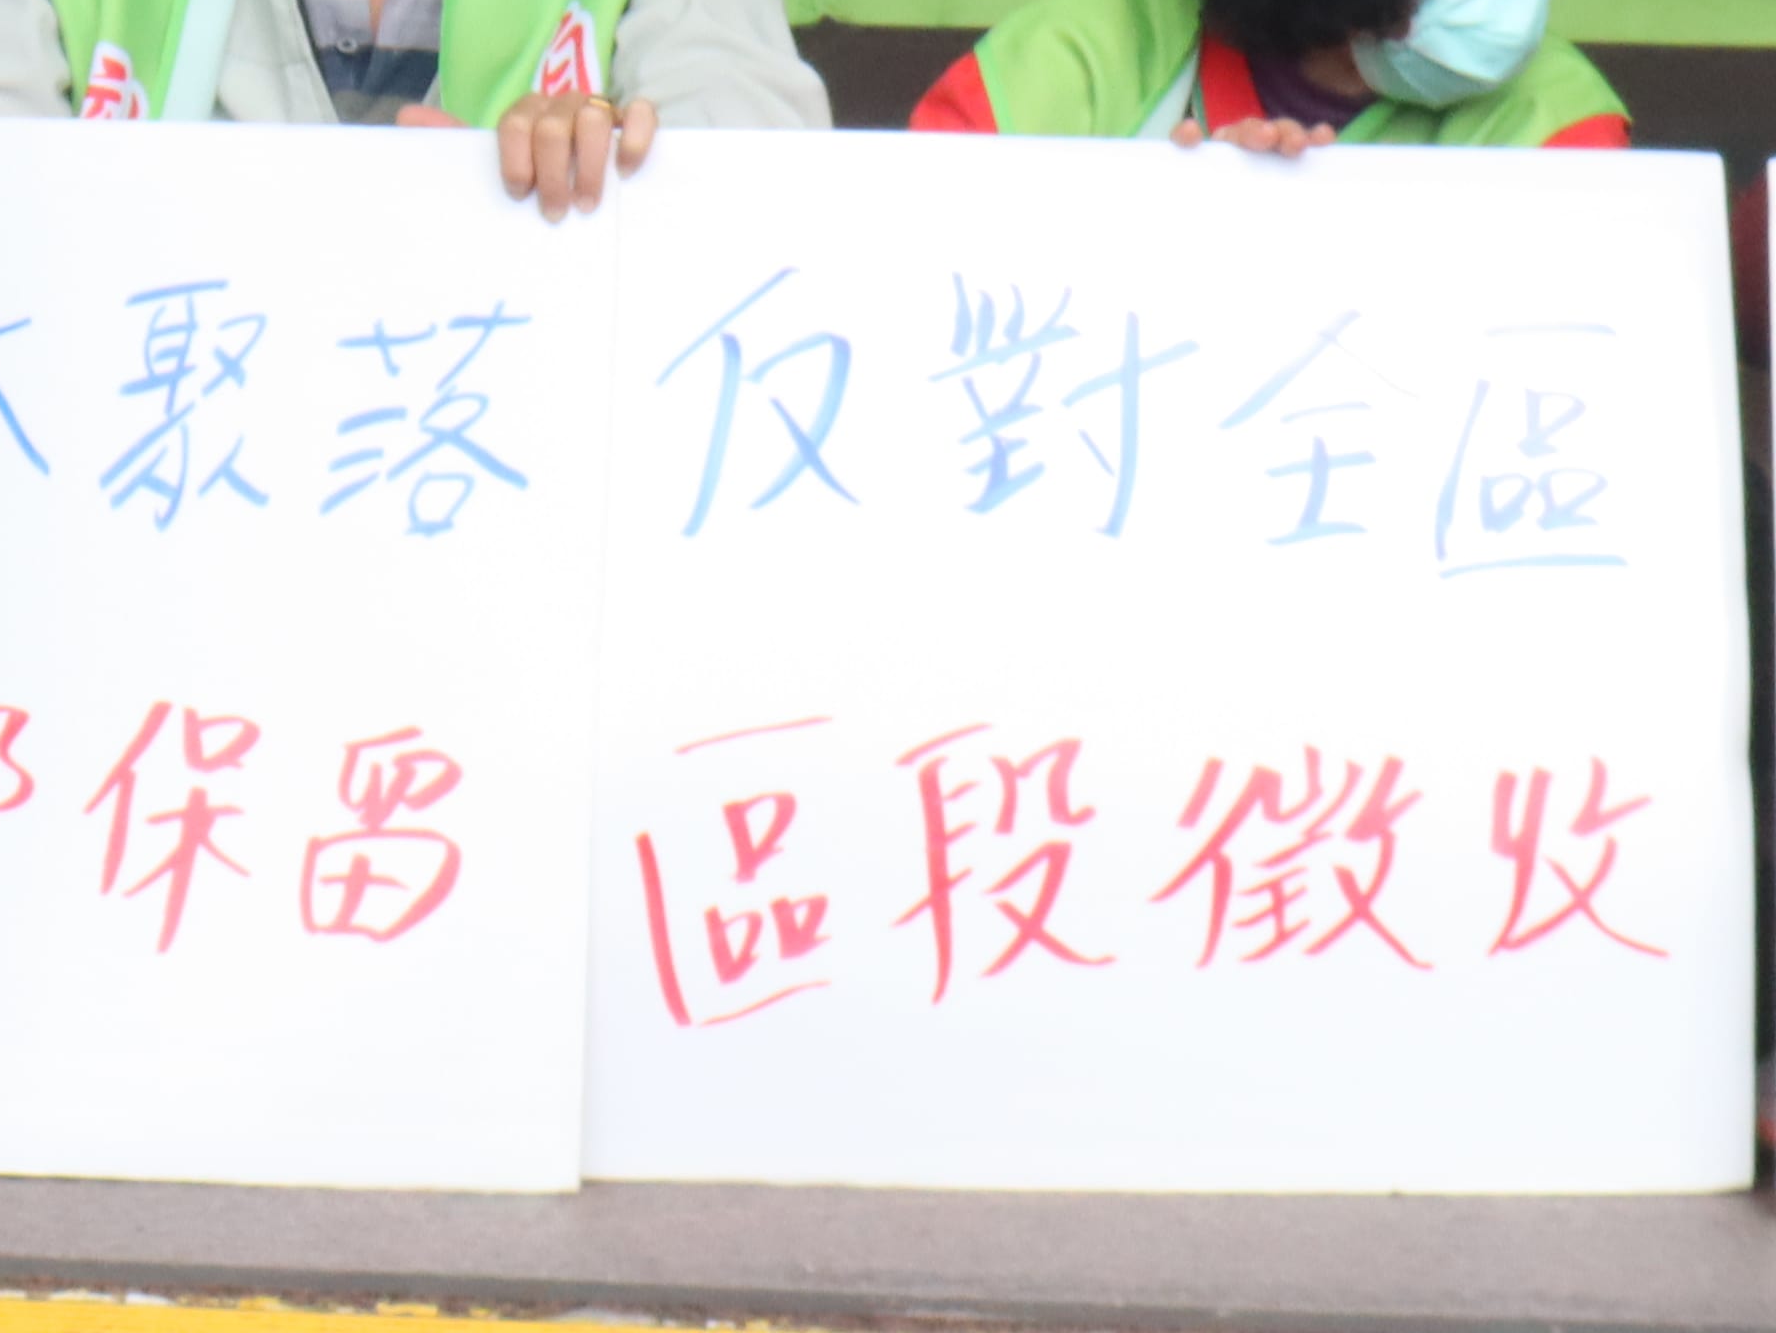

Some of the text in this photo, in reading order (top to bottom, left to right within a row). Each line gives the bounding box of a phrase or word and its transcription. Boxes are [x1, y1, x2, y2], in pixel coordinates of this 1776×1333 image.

[654, 266, 1629, 579] 反對全區
[635, 715, 1671, 1027] 區段徵收
